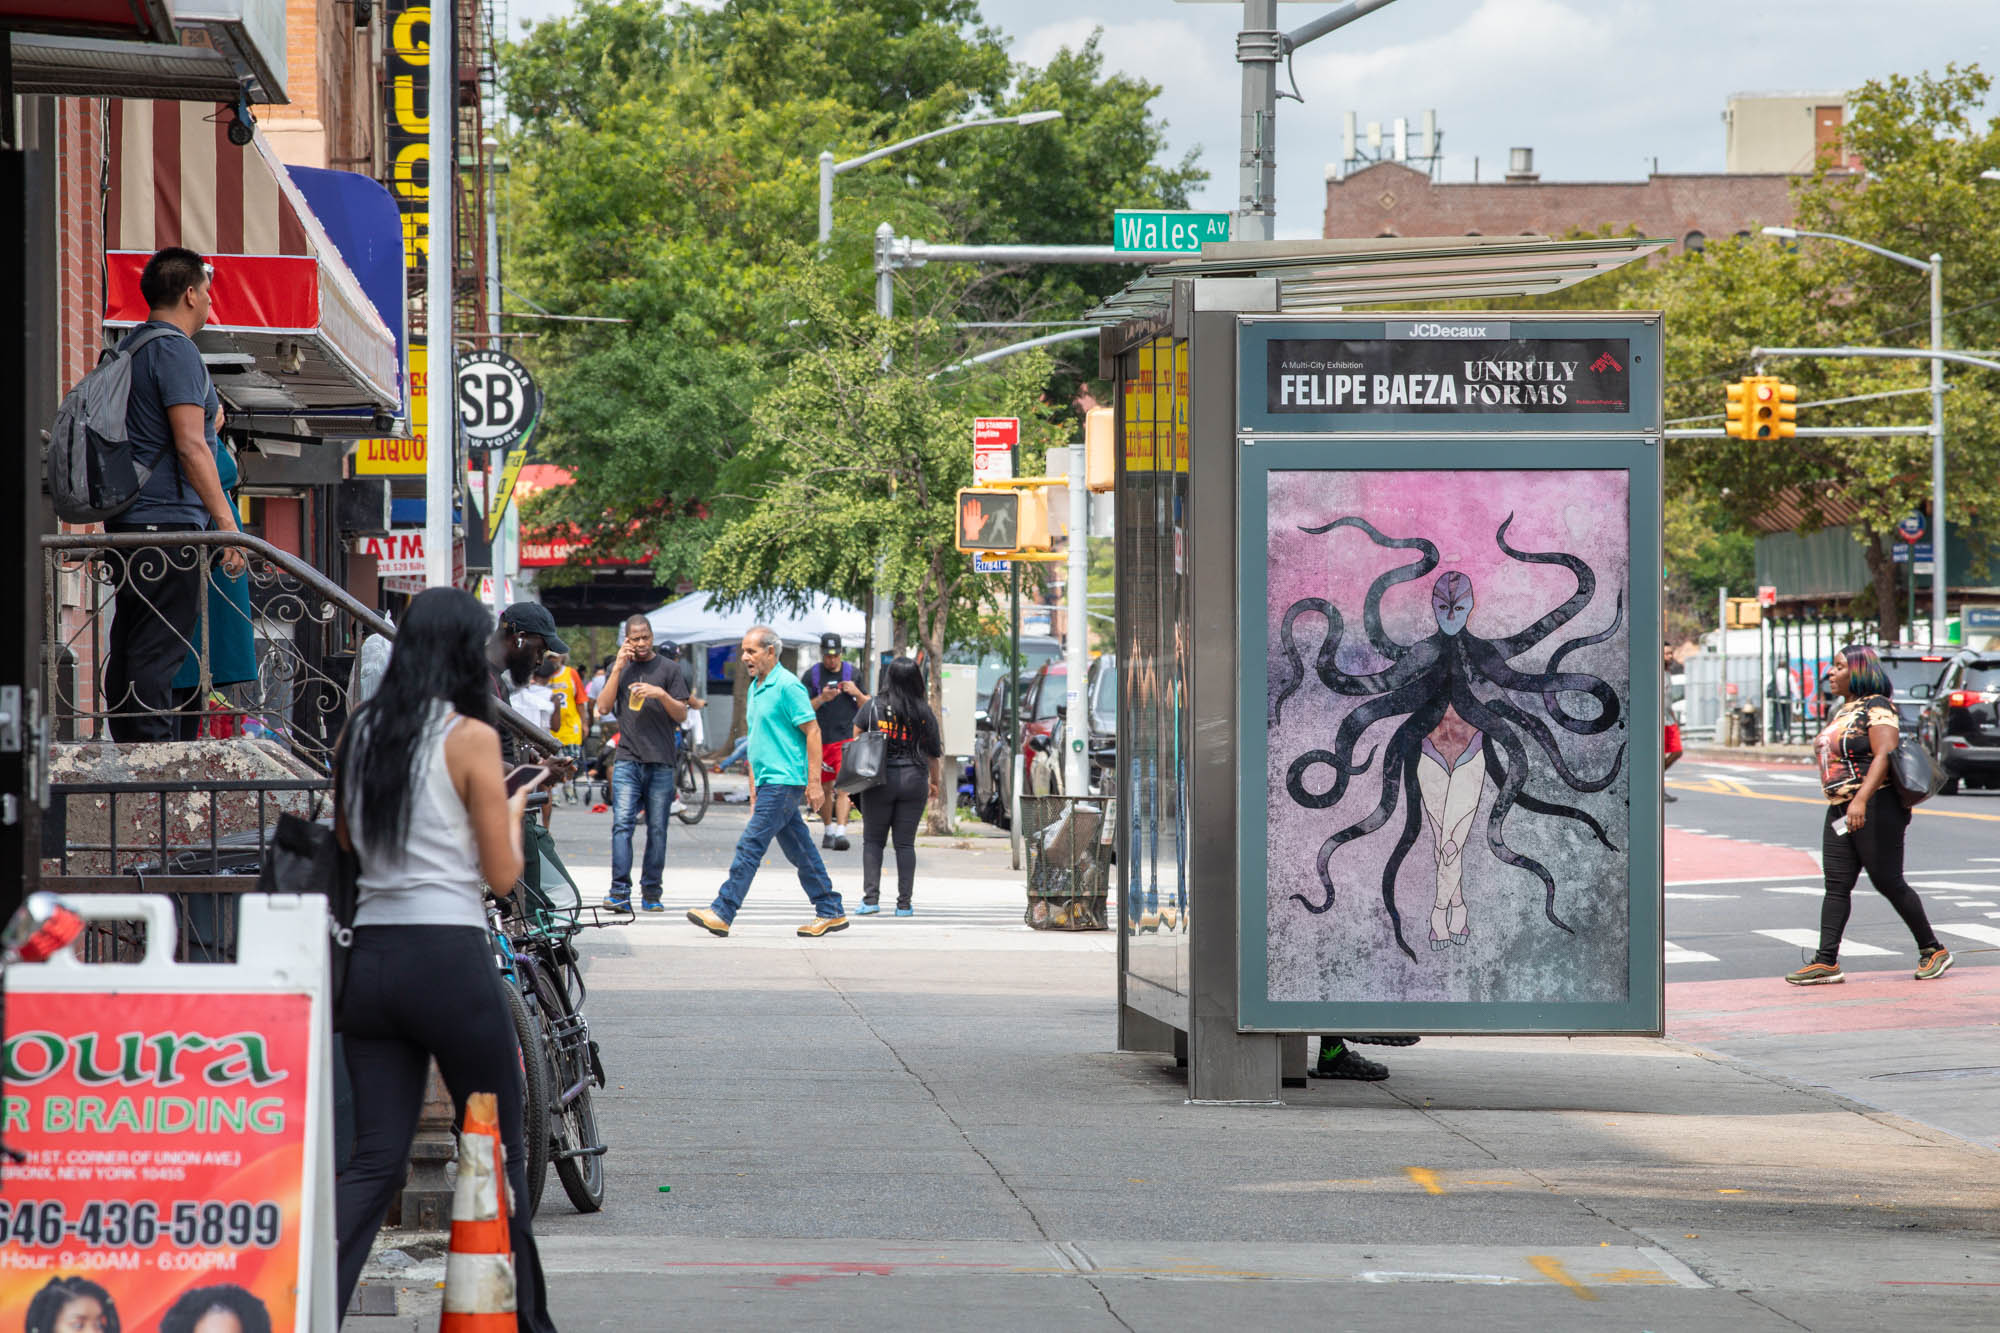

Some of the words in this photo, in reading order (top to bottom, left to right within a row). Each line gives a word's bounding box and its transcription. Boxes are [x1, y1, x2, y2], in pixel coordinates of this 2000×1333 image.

[1121, 215, 1199, 249] Wales
[1206, 218, 1226, 235] Av
[1409, 324, 1486, 338] JCDecaux
[505, 360, 530, 387] BAR
[1289, 361, 1326, 370] Multi-City
[1327, 361, 1363, 369] Exhibition
[1464, 361, 1579, 382] UNRULY
[1280, 374, 1367, 405] FELIPE
[1373, 374, 1458, 405] BAEZA
[1463, 384, 1568, 405] FORMS
[460, 373, 515, 428] SB
[367, 434, 427, 463] LIQUO
[486, 428, 521, 448] YORK
[366, 534, 425, 561] ATM
[522, 544, 552, 560] STEAK
[43, 1096, 286, 1134] BRAIDING
[67, 1151, 129, 1165] CORNER
[132, 1151, 152, 1164] OF
[154, 1151, 201, 1165] UNION
[58, 1166, 92, 1180] NEW
[94, 1166, 138, 1181] YORK
[1, 1252, 54, 1270] Hour:
[59, 1252, 139, 1270] 9:30AM
[158, 1252, 237, 1270] 6:00PM
